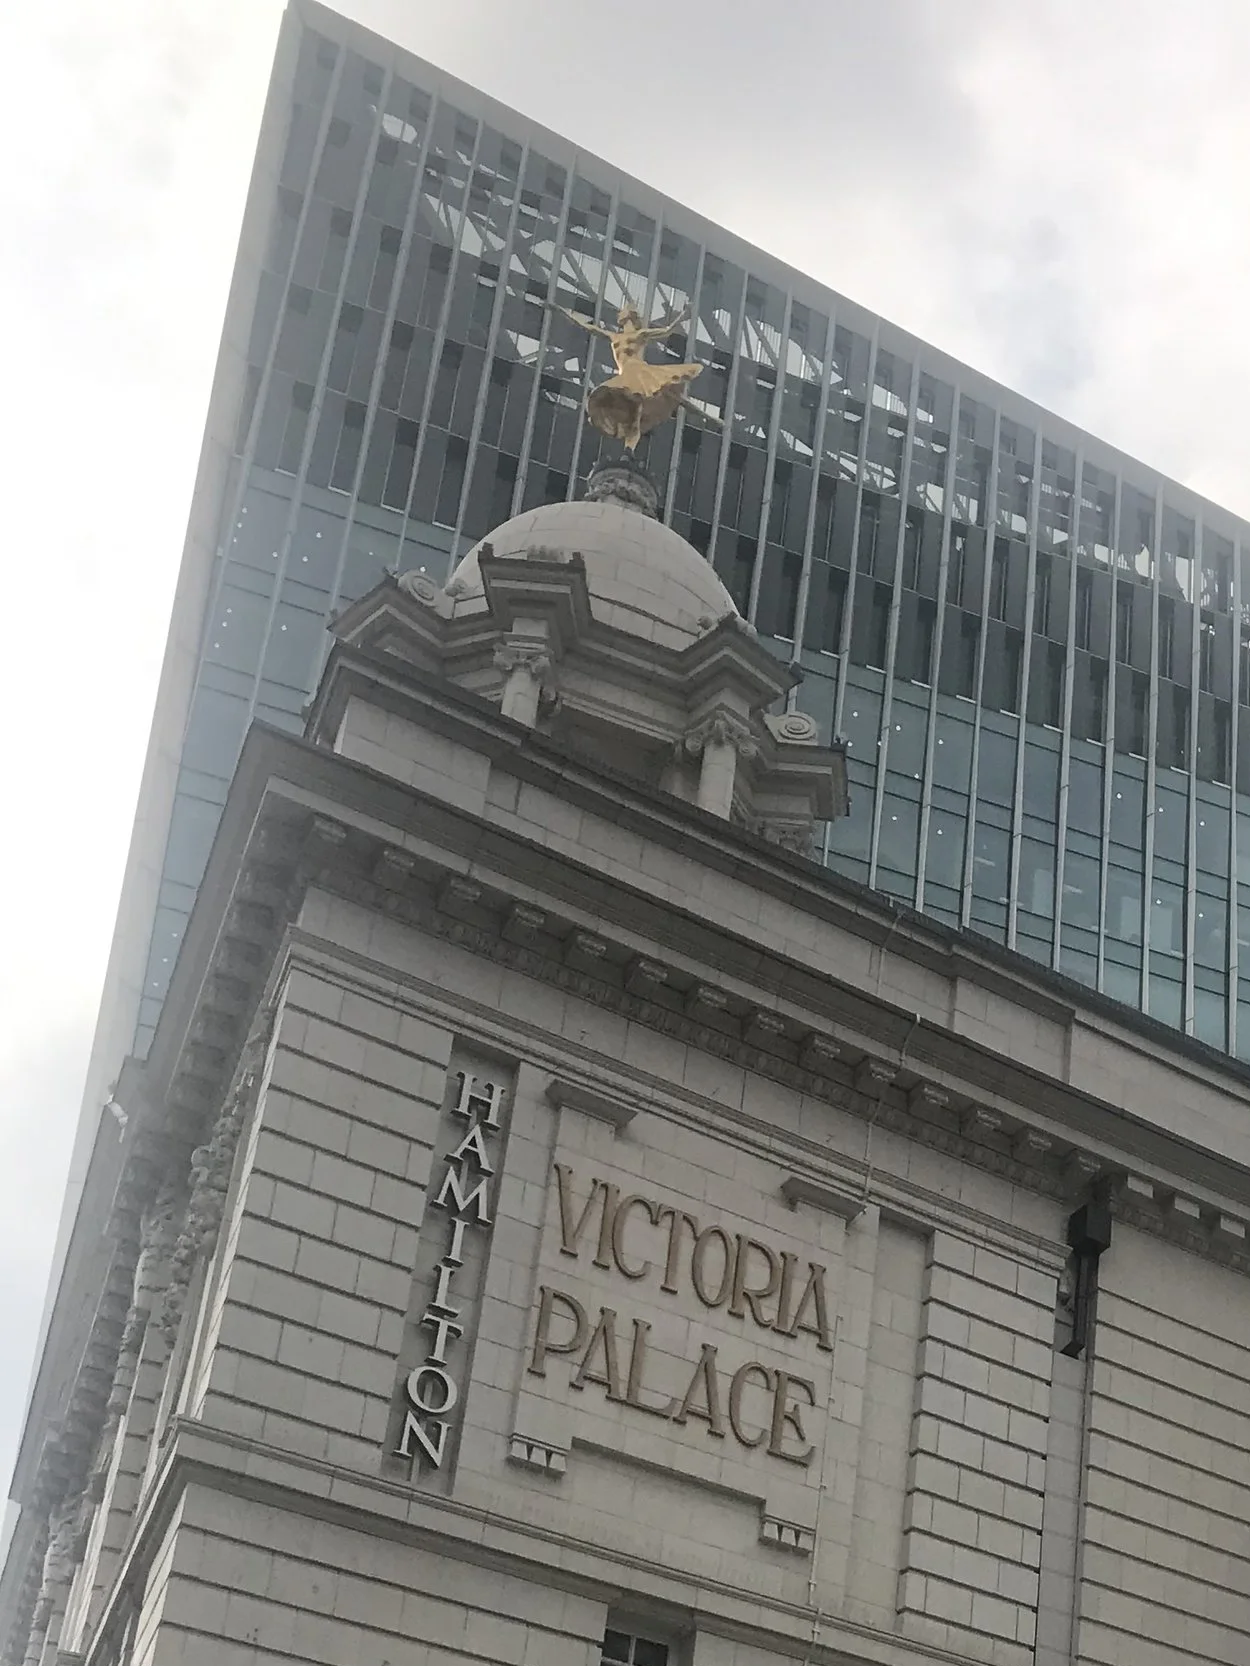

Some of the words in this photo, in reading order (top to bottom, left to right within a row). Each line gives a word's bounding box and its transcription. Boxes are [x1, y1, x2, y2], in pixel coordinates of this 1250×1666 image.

[393, 1071, 506, 1469] HAMILTON
[553, 1163, 834, 1352] VICTORIA
[527, 1285, 817, 1467] PALACE
